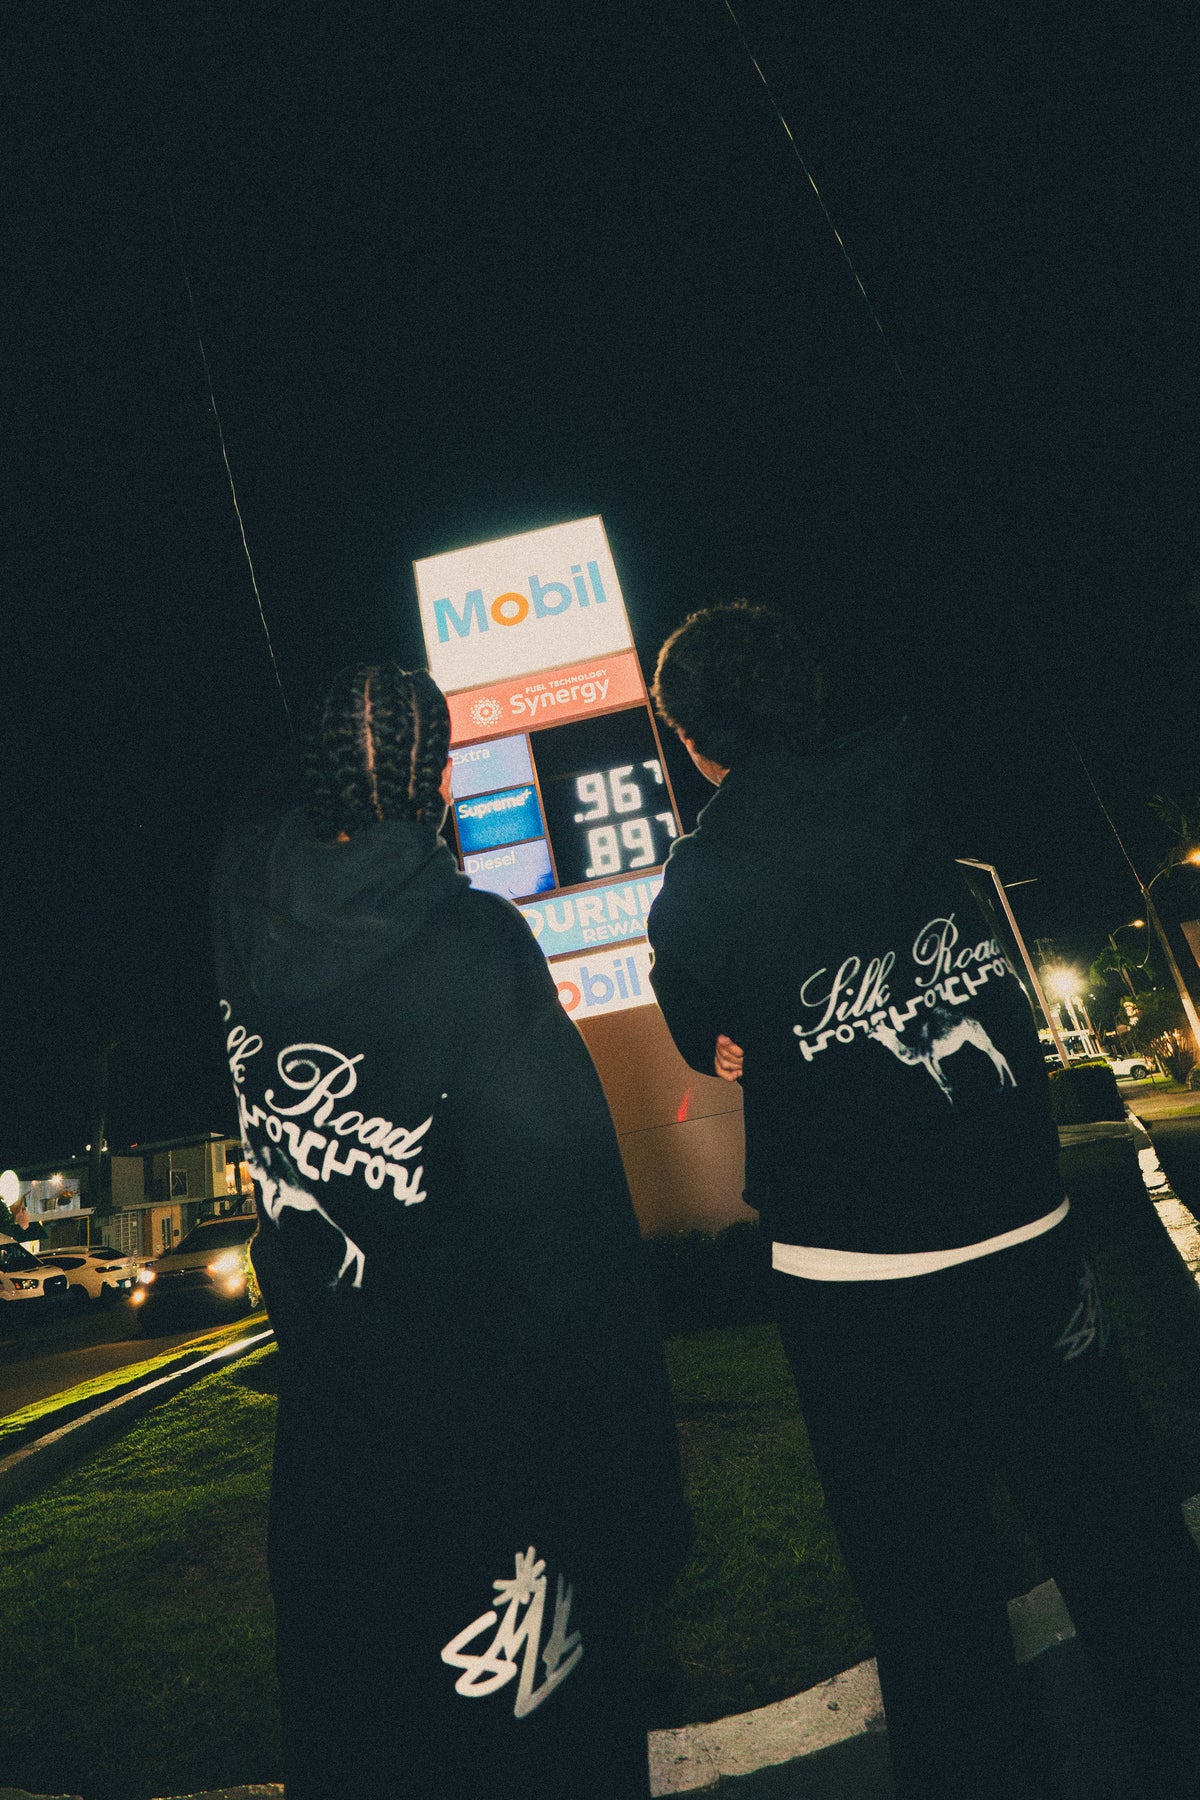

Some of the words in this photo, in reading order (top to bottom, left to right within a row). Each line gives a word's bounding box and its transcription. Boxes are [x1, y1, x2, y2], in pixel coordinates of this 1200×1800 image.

[433, 560, 608, 644] Mobil
[509, 679, 610, 716] Synergy
[525, 683, 547, 694] FUEL
[548, 669, 608, 688] TECHNOLOGY
[450, 748, 491, 765] Extra
[467, 851, 516, 874] Diesel
[521, 880, 664, 938] OURNI
[582, 915, 648, 944] REWA
[556, 956, 642, 1013] obil
[793, 951, 896, 1037] Silk
[264, 1043, 434, 1160] Road
